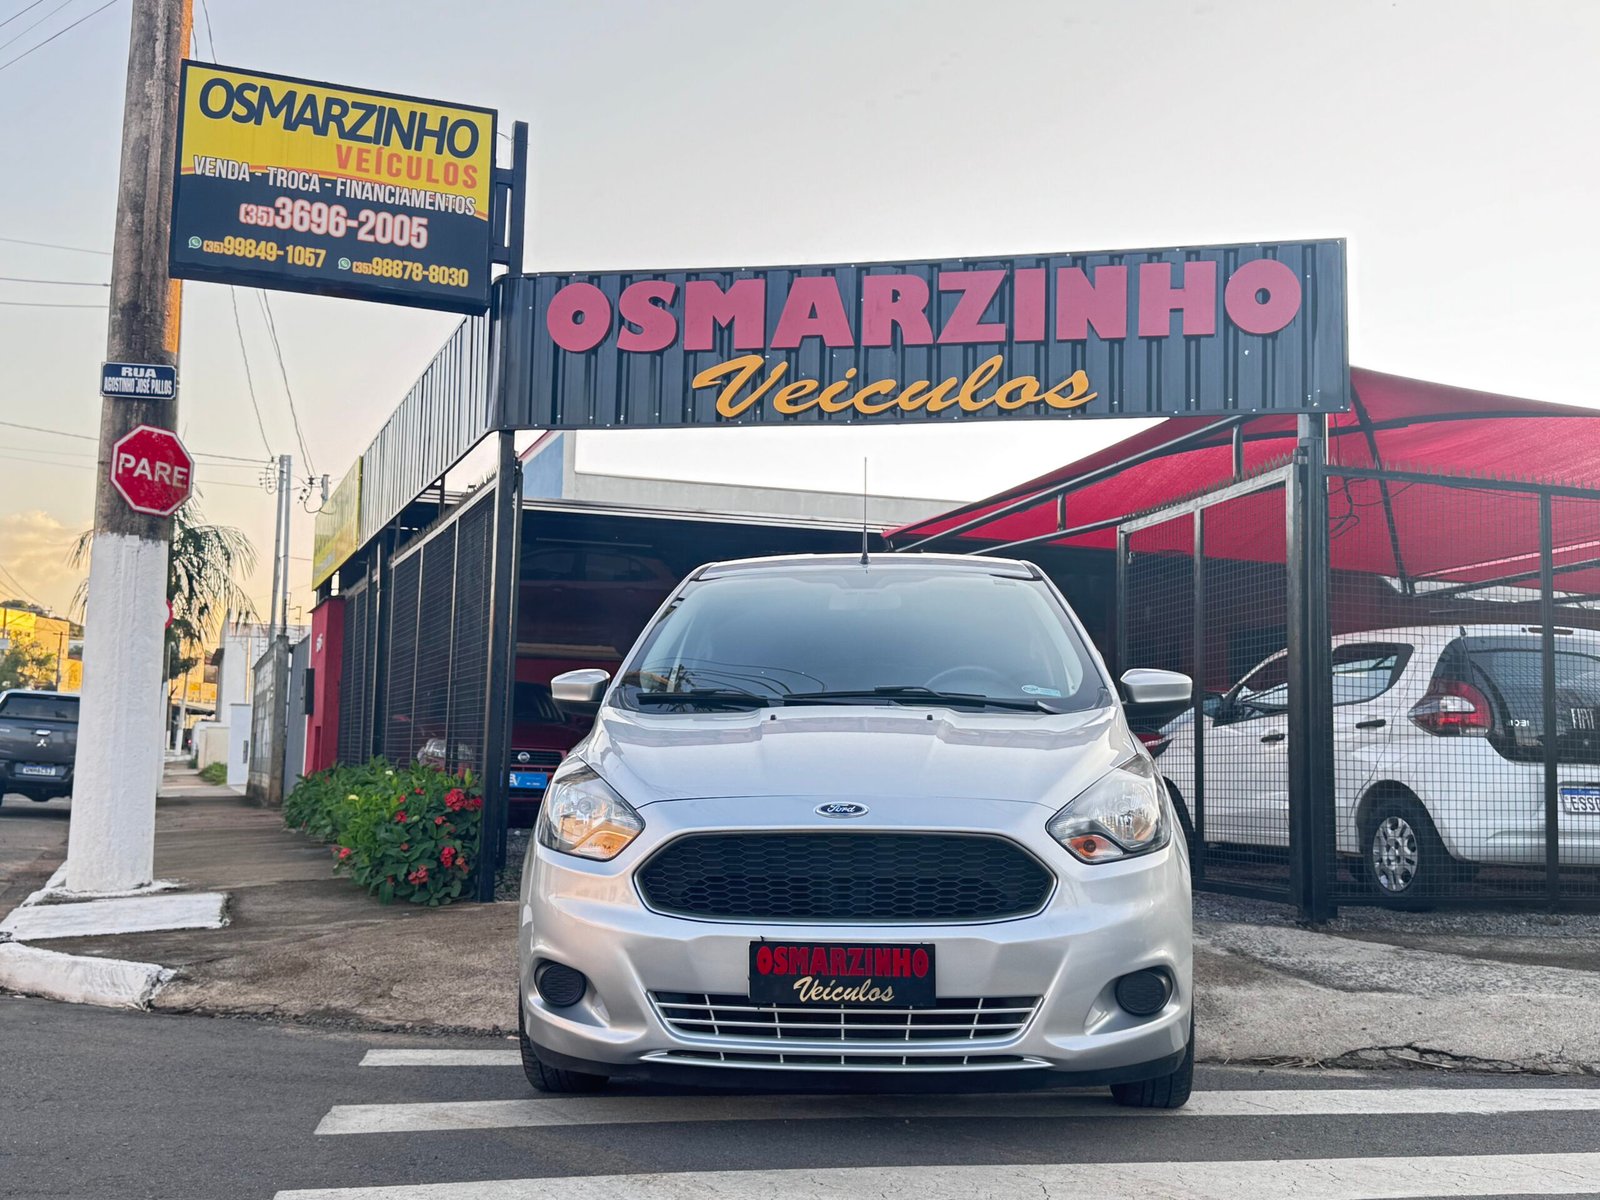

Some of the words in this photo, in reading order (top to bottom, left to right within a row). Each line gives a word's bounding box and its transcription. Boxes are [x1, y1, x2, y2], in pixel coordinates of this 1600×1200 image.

[199, 78, 480, 159] OSMARZINHO
[336, 144, 478, 189] VEÍCULOS
[193, 155, 250, 182] VENDA
[267, 166, 320, 193] TROCA
[336, 177, 477, 216] FINANCIAMENTOS
[239, 196, 429, 249] (35)3696-2005
[547, 259, 1302, 352] OSMARZINHO
[104, 377, 135, 393] AGOSTINHO
[135, 378, 150, 394] JOSÉ
[150, 380, 172, 395] PALLOS
[121, 367, 157, 378] RUA
[117, 453, 189, 489] PARE
[1571, 708, 1595, 729] FIAT
[827, 804, 856, 813] Ford
[757, 946, 929, 978] OSMARZINHO
